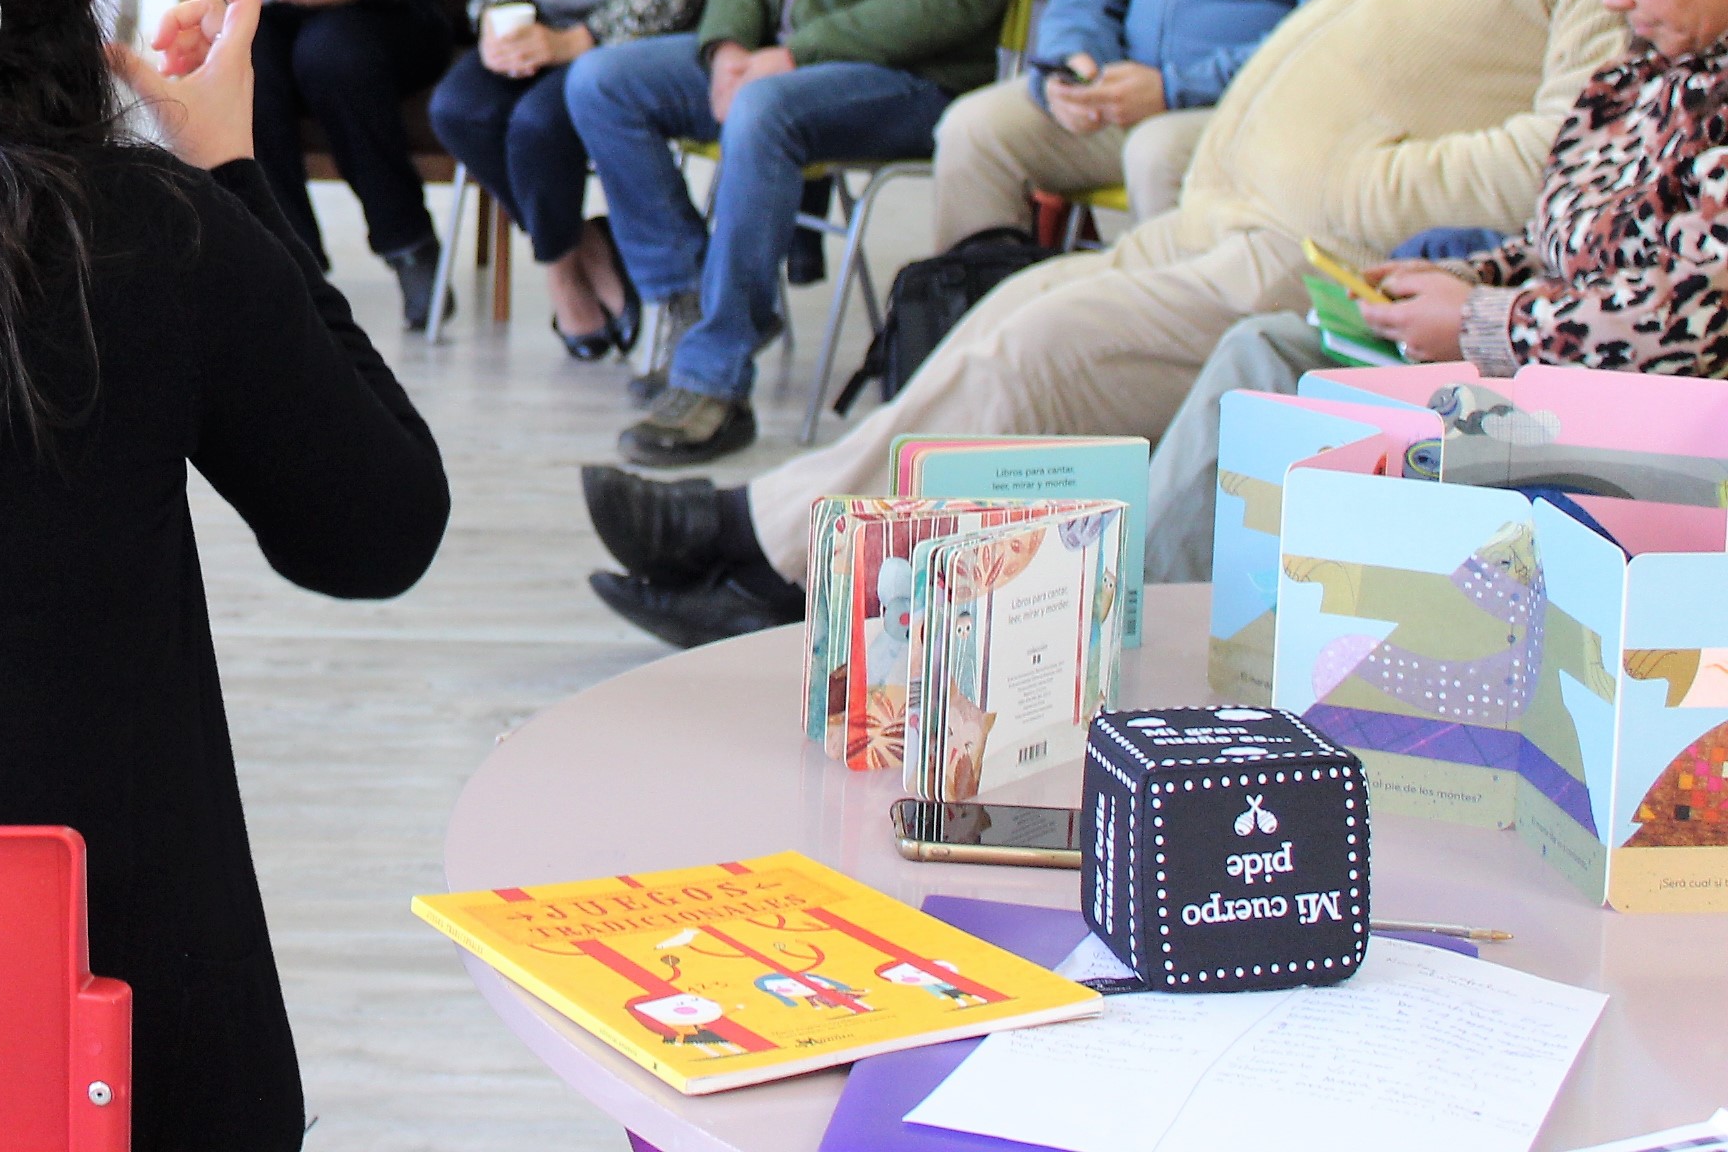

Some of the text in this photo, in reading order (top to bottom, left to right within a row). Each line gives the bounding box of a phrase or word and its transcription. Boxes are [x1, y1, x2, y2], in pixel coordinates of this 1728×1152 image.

[996, 468, 1023, 478] Libros
[1025, 467, 1045, 478] para
[1013, 481, 1034, 489] mirar
[1011, 597, 1031, 610] Libros
[1032, 592, 1047, 605] para
[1141, 726, 1249, 738] Mi gran
[1153, 734, 1233, 746] sueño
[1403, 783, 1417, 793] de
[1419, 786, 1433, 797] los
[1436, 790, 1482, 803] montes?
[1105, 795, 1116, 935] cuando...
[1226, 841, 1294, 884] pide
[546, 881, 748, 920] JUEGOS
[1093, 864, 1104, 926] Soy
[1181, 890, 1342, 926] Mi cuerpo
[529, 893, 806, 939] TRADICIONALES
